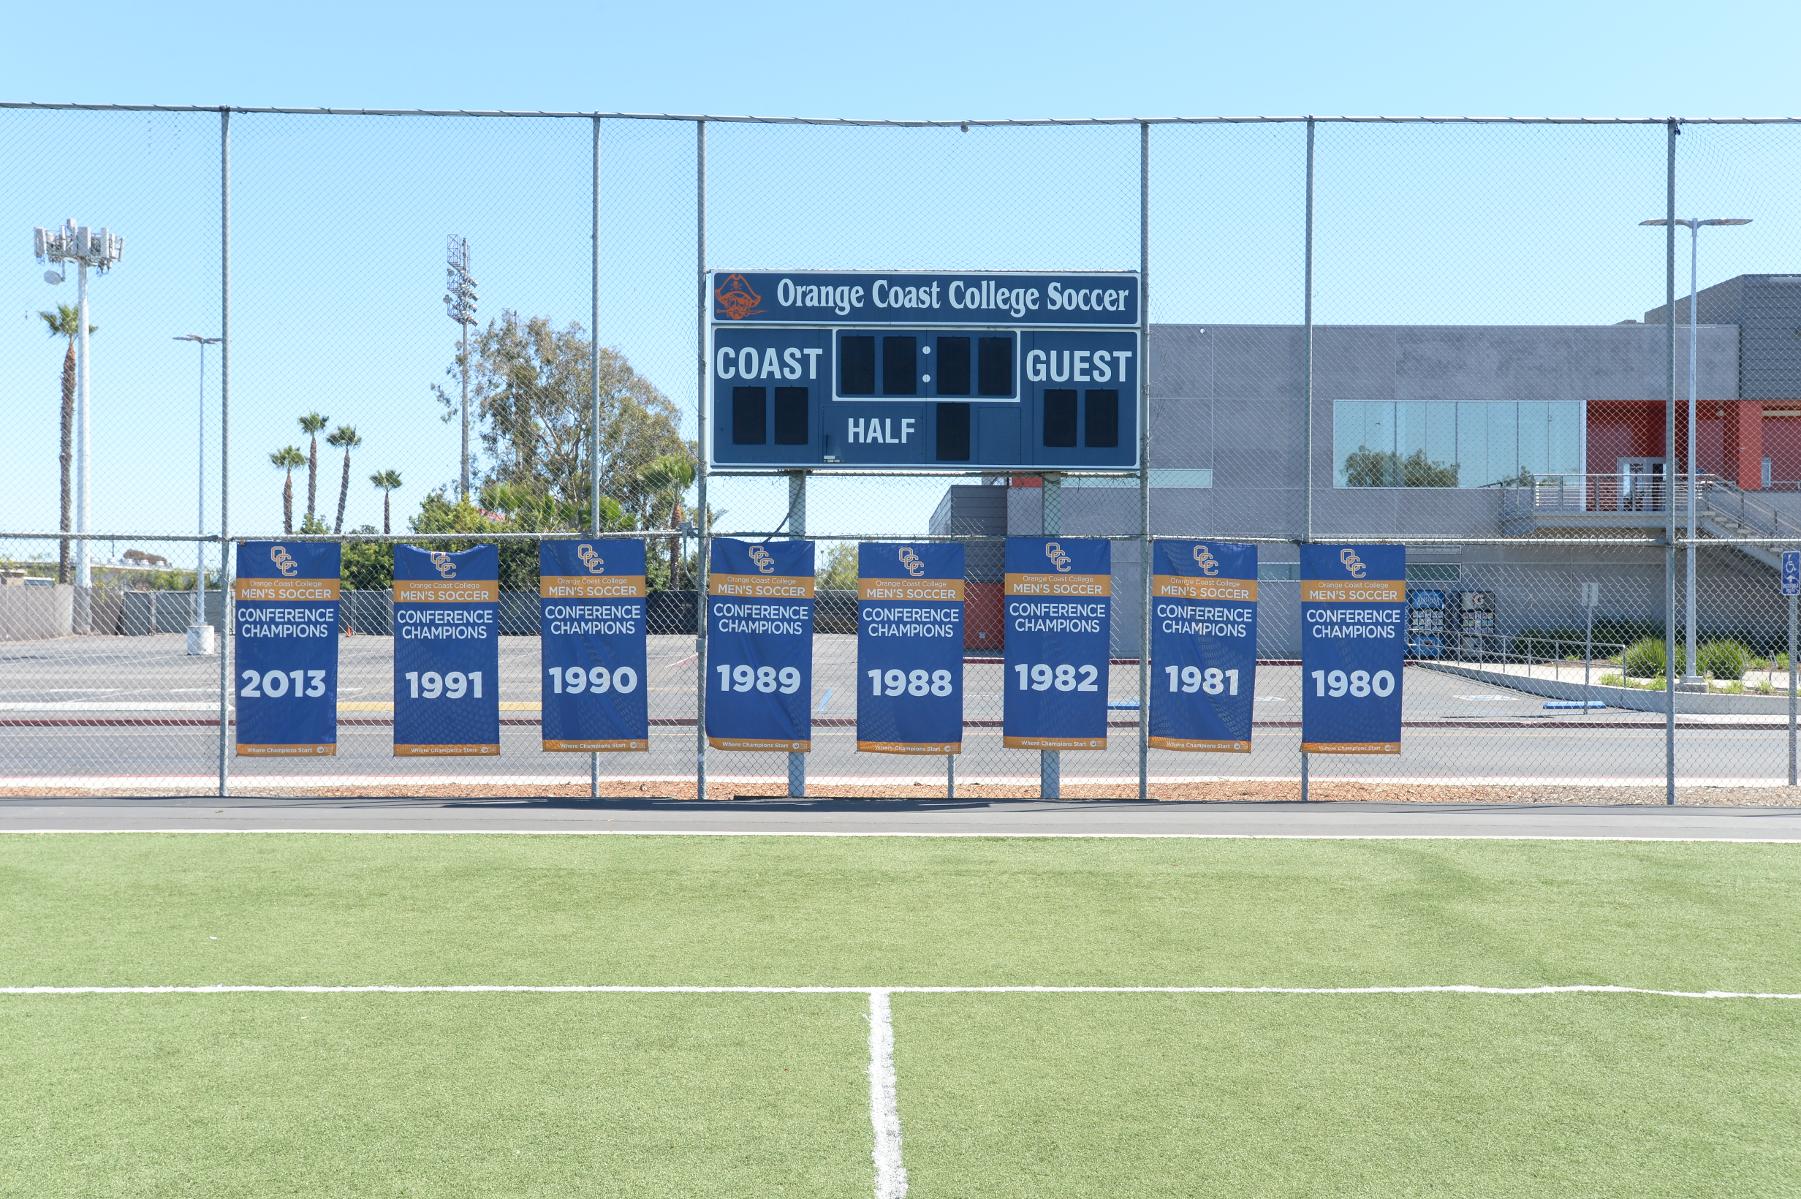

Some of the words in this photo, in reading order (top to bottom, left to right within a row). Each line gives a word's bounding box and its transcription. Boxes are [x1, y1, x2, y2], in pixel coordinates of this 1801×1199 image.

[777, 278, 864, 315] Orange
[872, 280, 941, 309] Coast
[950, 280, 1039, 317] College
[1047, 282, 1128, 311] Soccer
[717, 347, 822, 380] COAST
[1026, 350, 1132, 382] GUEST
[848, 418, 915, 444] HALF
[241, 590, 275, 598] MEN'S
[279, 589, 331, 598] SOCCER
[401, 591, 434, 600] MEN'S
[438, 591, 488, 600] SOCCER
[549, 586, 584, 596] MEN'S
[587, 586, 637, 595] SOCCER
[718, 584, 752, 594] MEN'S
[755, 585, 805, 596] SOCCER
[867, 589, 903, 598] MEN'S
[907, 589, 956, 598] SOCCER
[1014, 584, 1049, 593] MEN'S
[1053, 584, 1102, 594] SOCCER
[1161, 586, 1196, 596] MEN'S
[1200, 588, 1248, 598] SOCCER
[1310, 591, 1345, 600] MEN'S
[1349, 591, 1397, 600] SOCCER
[238, 608, 334, 621] CONFERENCE
[397, 610, 492, 623] CONFERENCE
[545, 606, 640, 618] CONFERENCE
[714, 603, 808, 619] CONFERENCE
[863, 608, 959, 621] CONFERENCE
[1010, 603, 1105, 617] CONFERENCE
[1157, 605, 1252, 621] CONFERENCE
[1307, 610, 1400, 622] CONFERENCE
[242, 624, 328, 637] CHAMPIONS
[551, 621, 635, 634] CHAMPIONS
[719, 619, 802, 634] CHAMPIONS
[869, 624, 953, 637] CHAMPIONS
[1015, 619, 1099, 632] CHAMPIONS
[1162, 621, 1246, 637] CHAMPIONS
[1312, 625, 1395, 638] CHAMPIONS
[403, 626, 487, 639] CHAMPIONS
[241, 670, 326, 697] 2013
[548, 666, 638, 694] 1990
[717, 664, 800, 694] 1989
[868, 669, 952, 696] 1988
[1015, 664, 1098, 691] 1982
[1165, 666, 1239, 695] 1981
[1312, 670, 1395, 697] 1980
[405, 672, 482, 698] 1991
